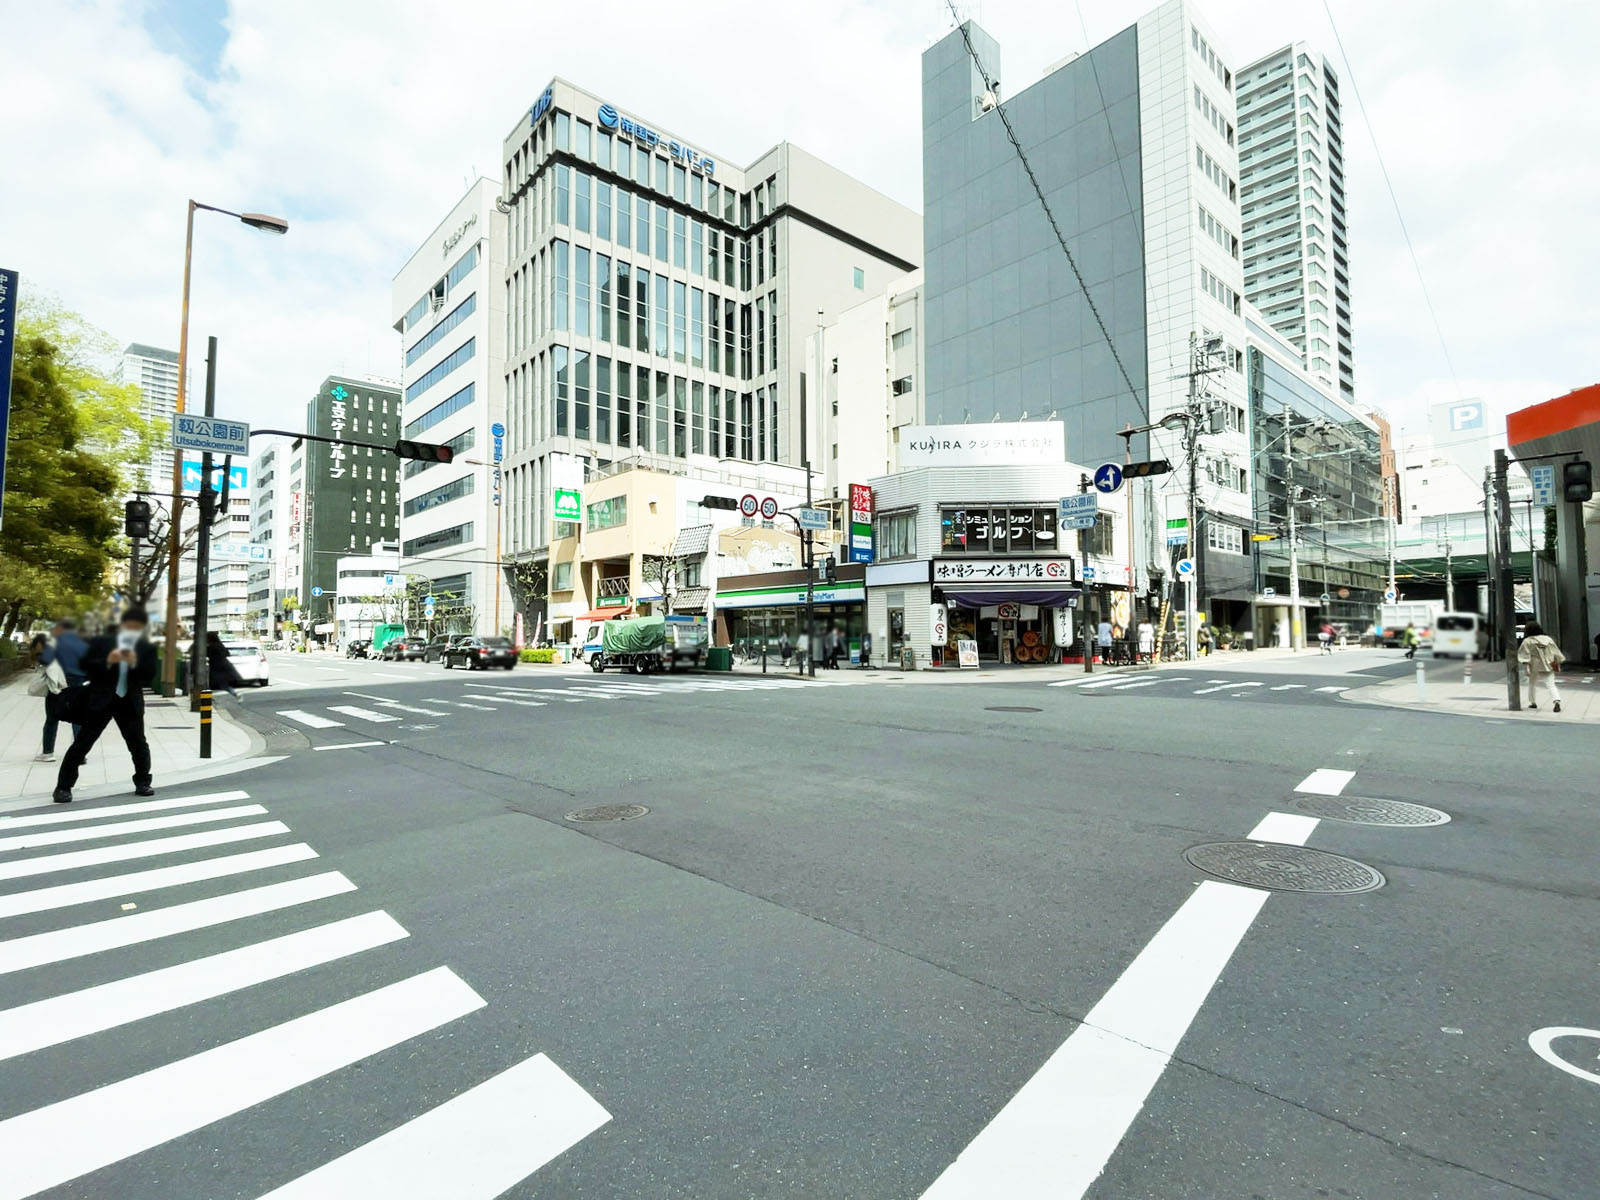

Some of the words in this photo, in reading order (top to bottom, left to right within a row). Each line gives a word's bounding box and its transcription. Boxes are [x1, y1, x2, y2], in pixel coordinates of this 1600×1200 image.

[175, 435, 245, 452] Utsubokoenmae
[743, 501, 755, 513] 60
[764, 502, 775, 514] 50
[966, 514, 1033, 525] シミュレーション
[975, 525, 1024, 540] ゴルフ
[936, 563, 1043, 578] 味噌ラーメン専門店
